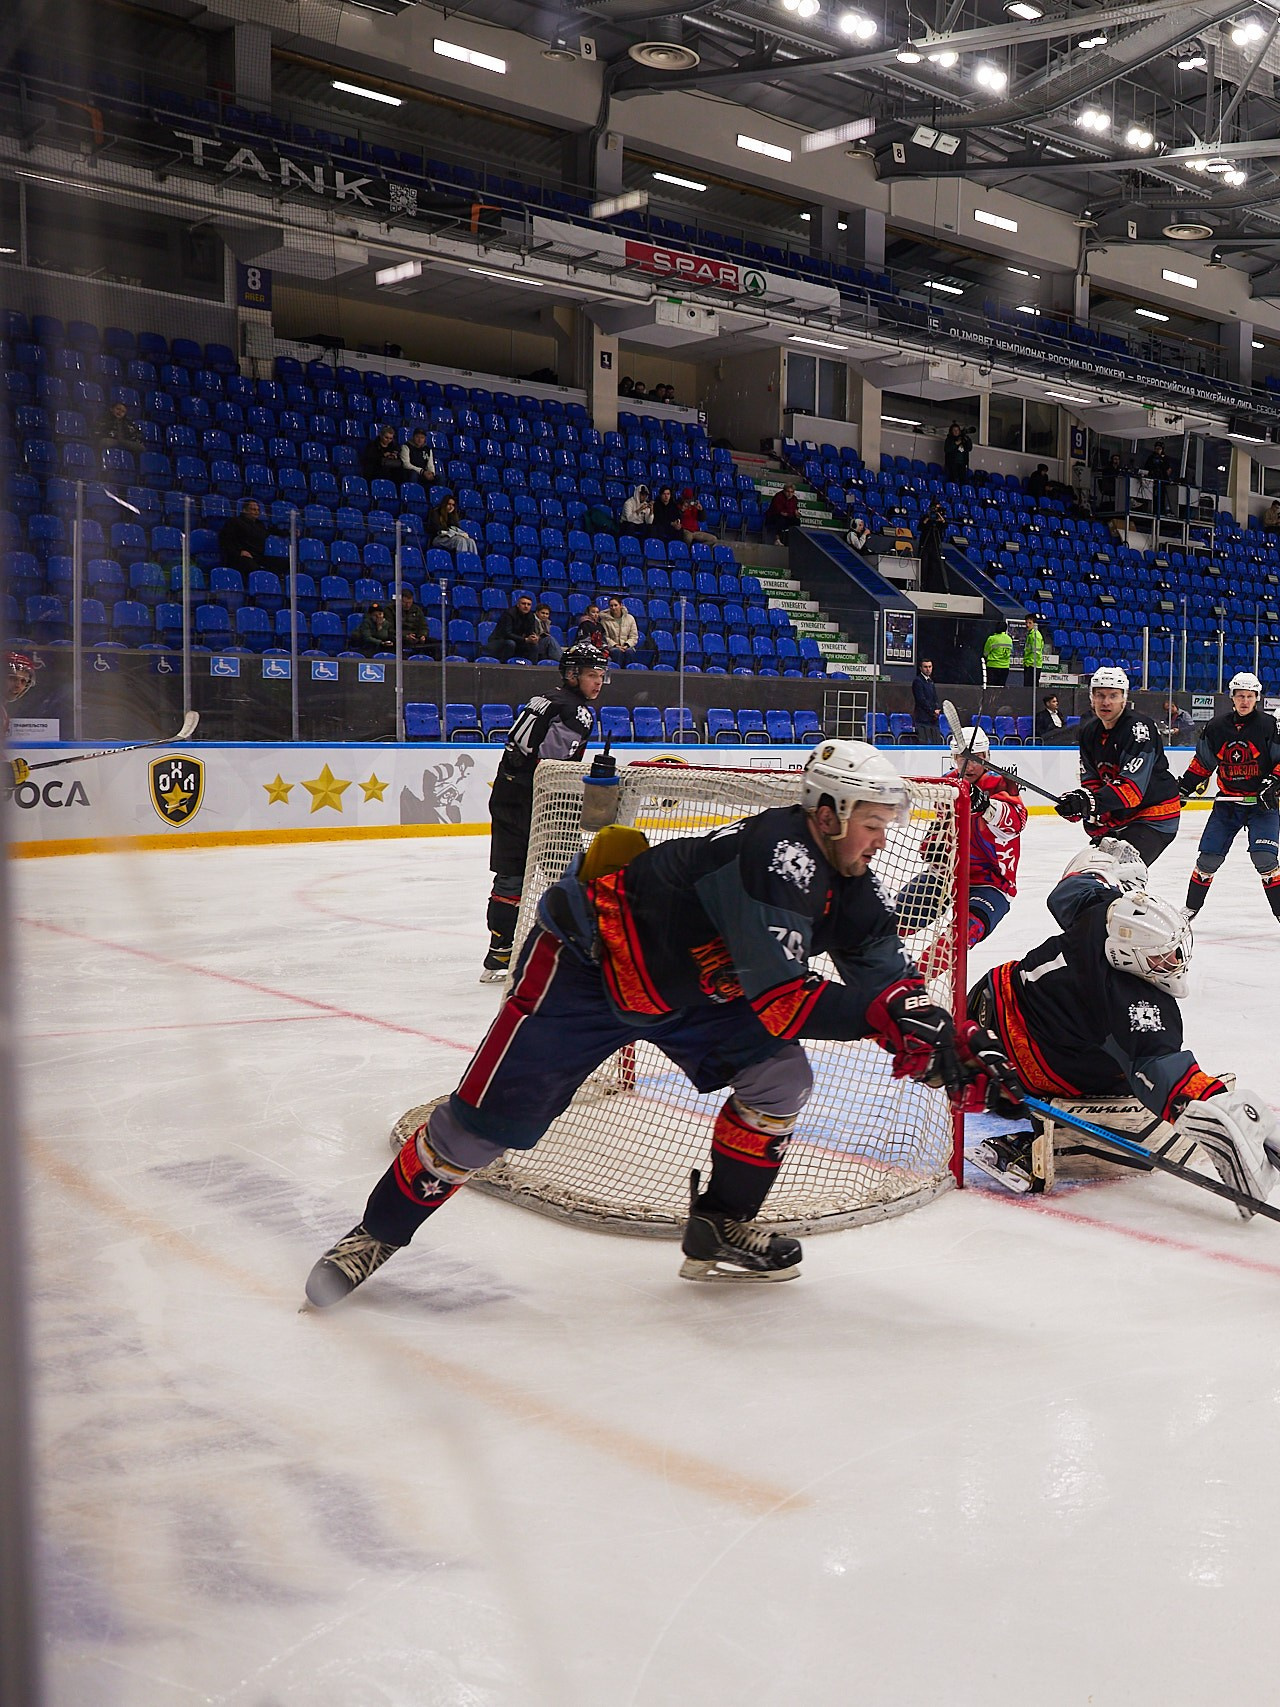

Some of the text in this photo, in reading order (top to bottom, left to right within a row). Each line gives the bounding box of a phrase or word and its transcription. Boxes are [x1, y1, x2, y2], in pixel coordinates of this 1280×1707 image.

[584, 43, 593, 55] 9
[896, 148, 903, 159] 8
[172, 130, 374, 207] TANK
[653, 251, 737, 287] SPAR
[247, 268, 261, 290] 8
[603, 354, 610, 365] 1
[949, 327, 995, 347] OLIMPBET
[995, 338, 1046, 360] ЧЕМПИОНАТ
[1048, 353, 1081, 370] РОССИИ
[1082, 361, 1094, 372] ПО
[1095, 363, 1126, 379] ХОККЕЮ
[1136, 373, 1195, 397] ВСЕРОССИЙСКАЯ
[1196, 387, 1236, 405] ХОККЕЙНАЯ
[1237, 398, 1253, 411] ЛИГА
[699, 412, 706, 423] 5
[1075, 432, 1083, 448] 9
[763, 580, 789, 589] SYNERGETIC
[781, 601, 807, 610] SYNERGETIC
[800, 621, 826, 630] SYNERGETIC
[821, 642, 847, 651] SYNERGETIC
[841, 663, 867, 672] SYNERGETIC
[4, 780, 91, 810] ОСА
[1019, 951, 1068, 987] 1
[1134, 1070, 1155, 1091] 1
